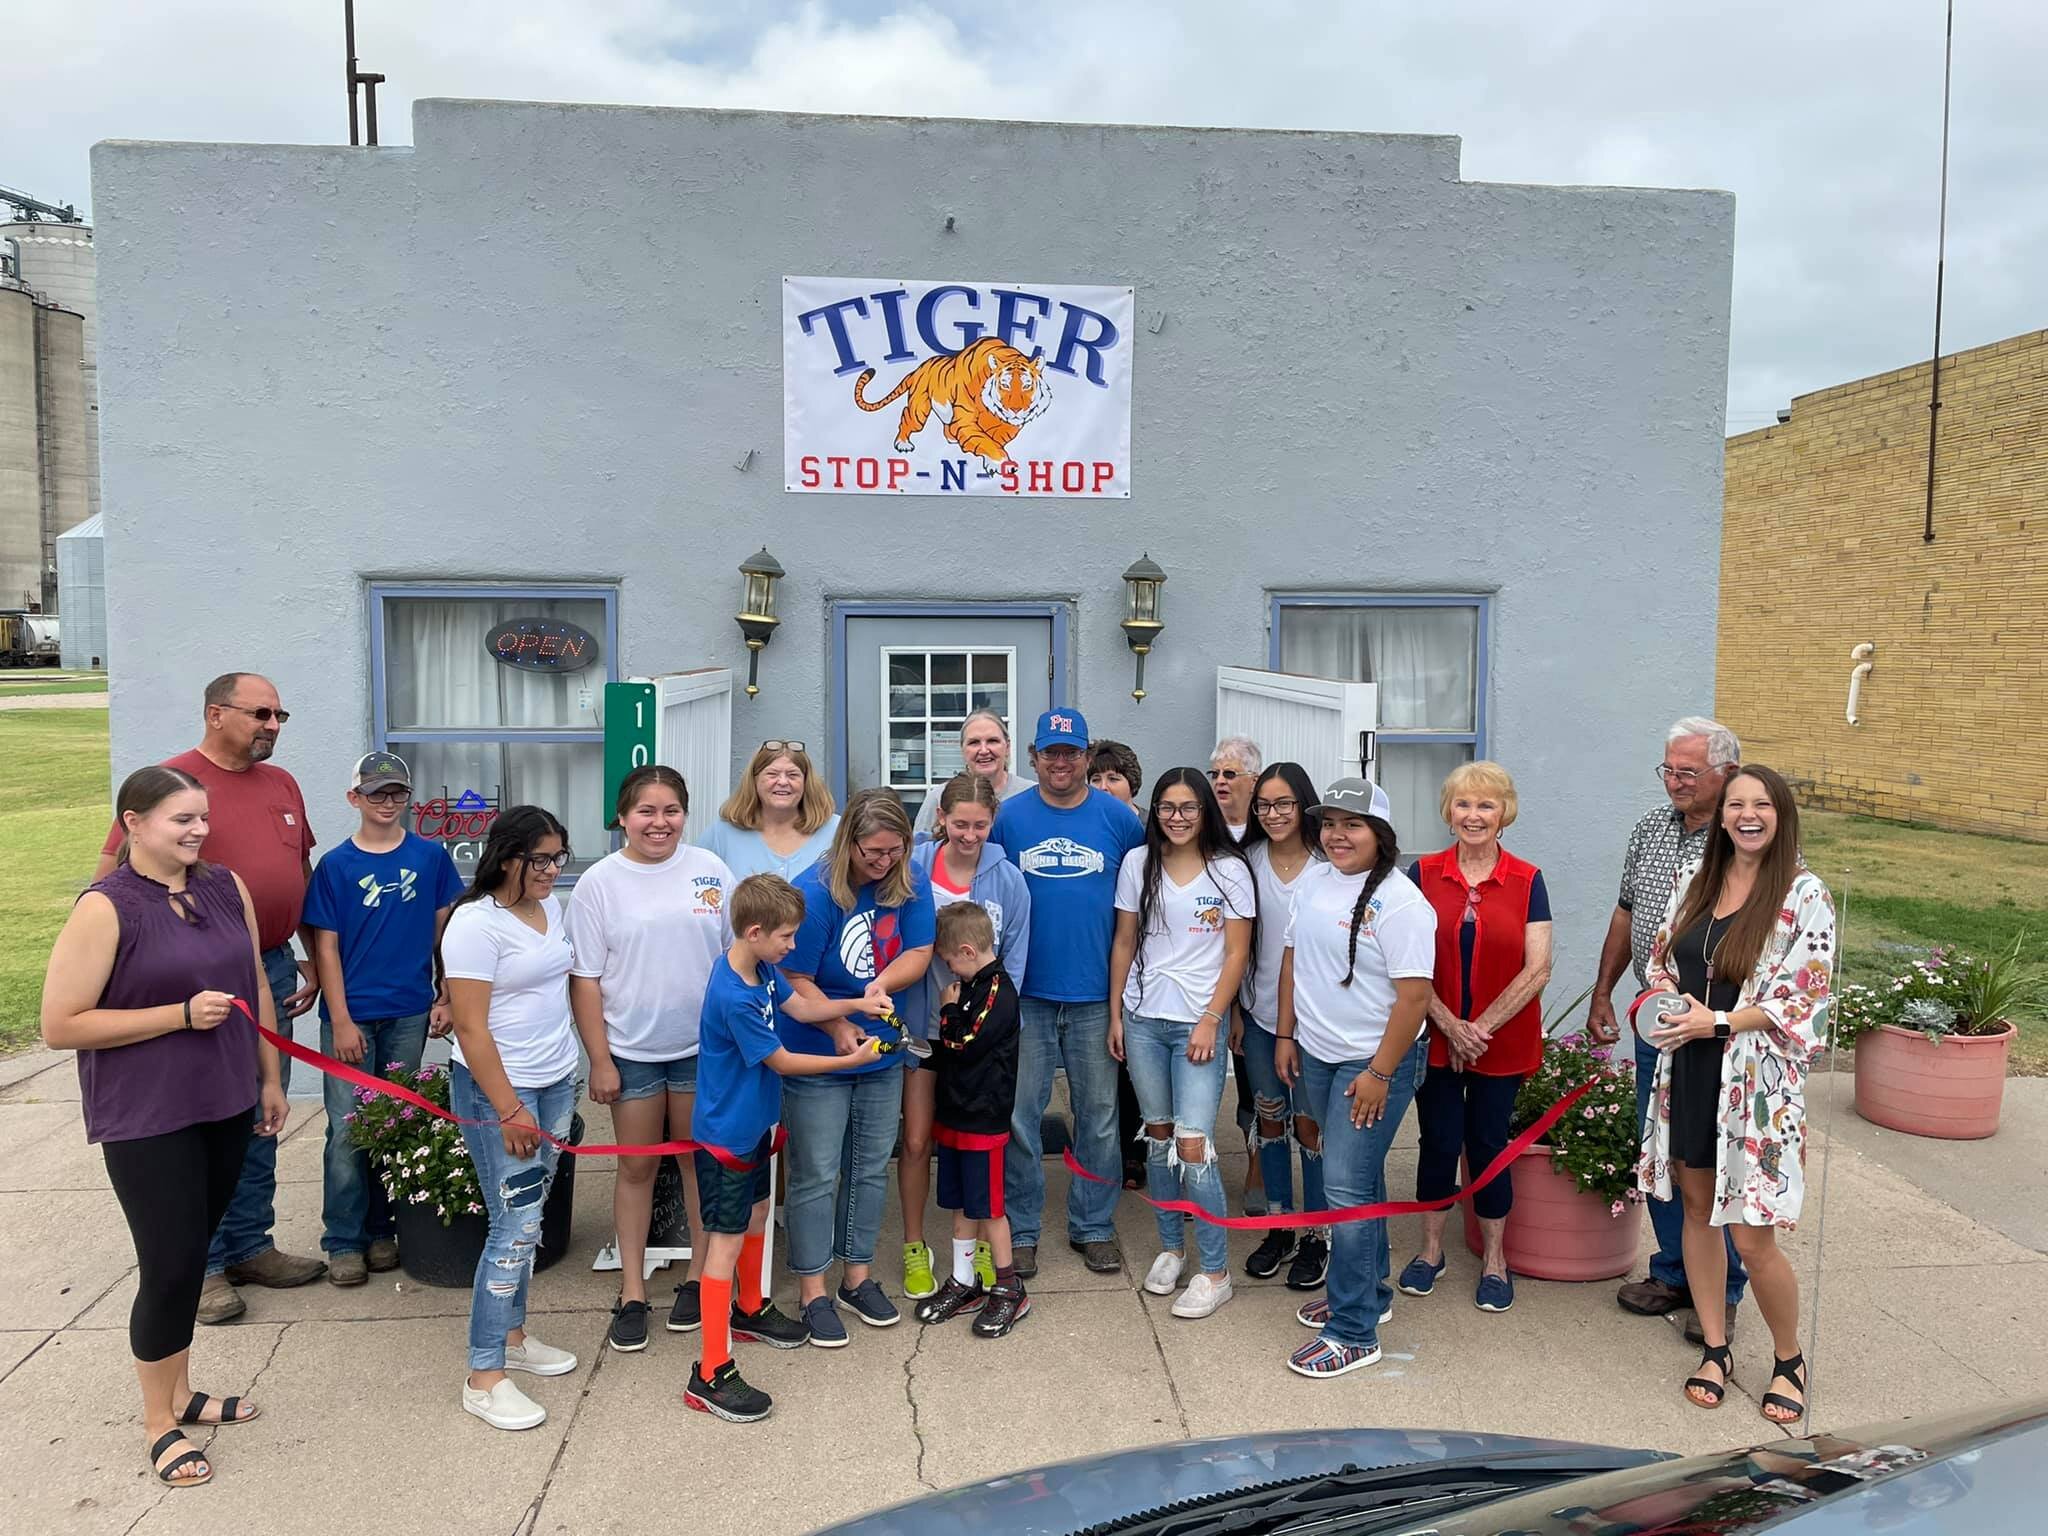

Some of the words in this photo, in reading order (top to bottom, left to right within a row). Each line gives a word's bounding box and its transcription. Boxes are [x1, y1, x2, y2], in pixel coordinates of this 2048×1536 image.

[798, 285, 1119, 388] TIGER
[497, 632, 585, 657] OPEN
[1050, 715, 1072, 732] PH
